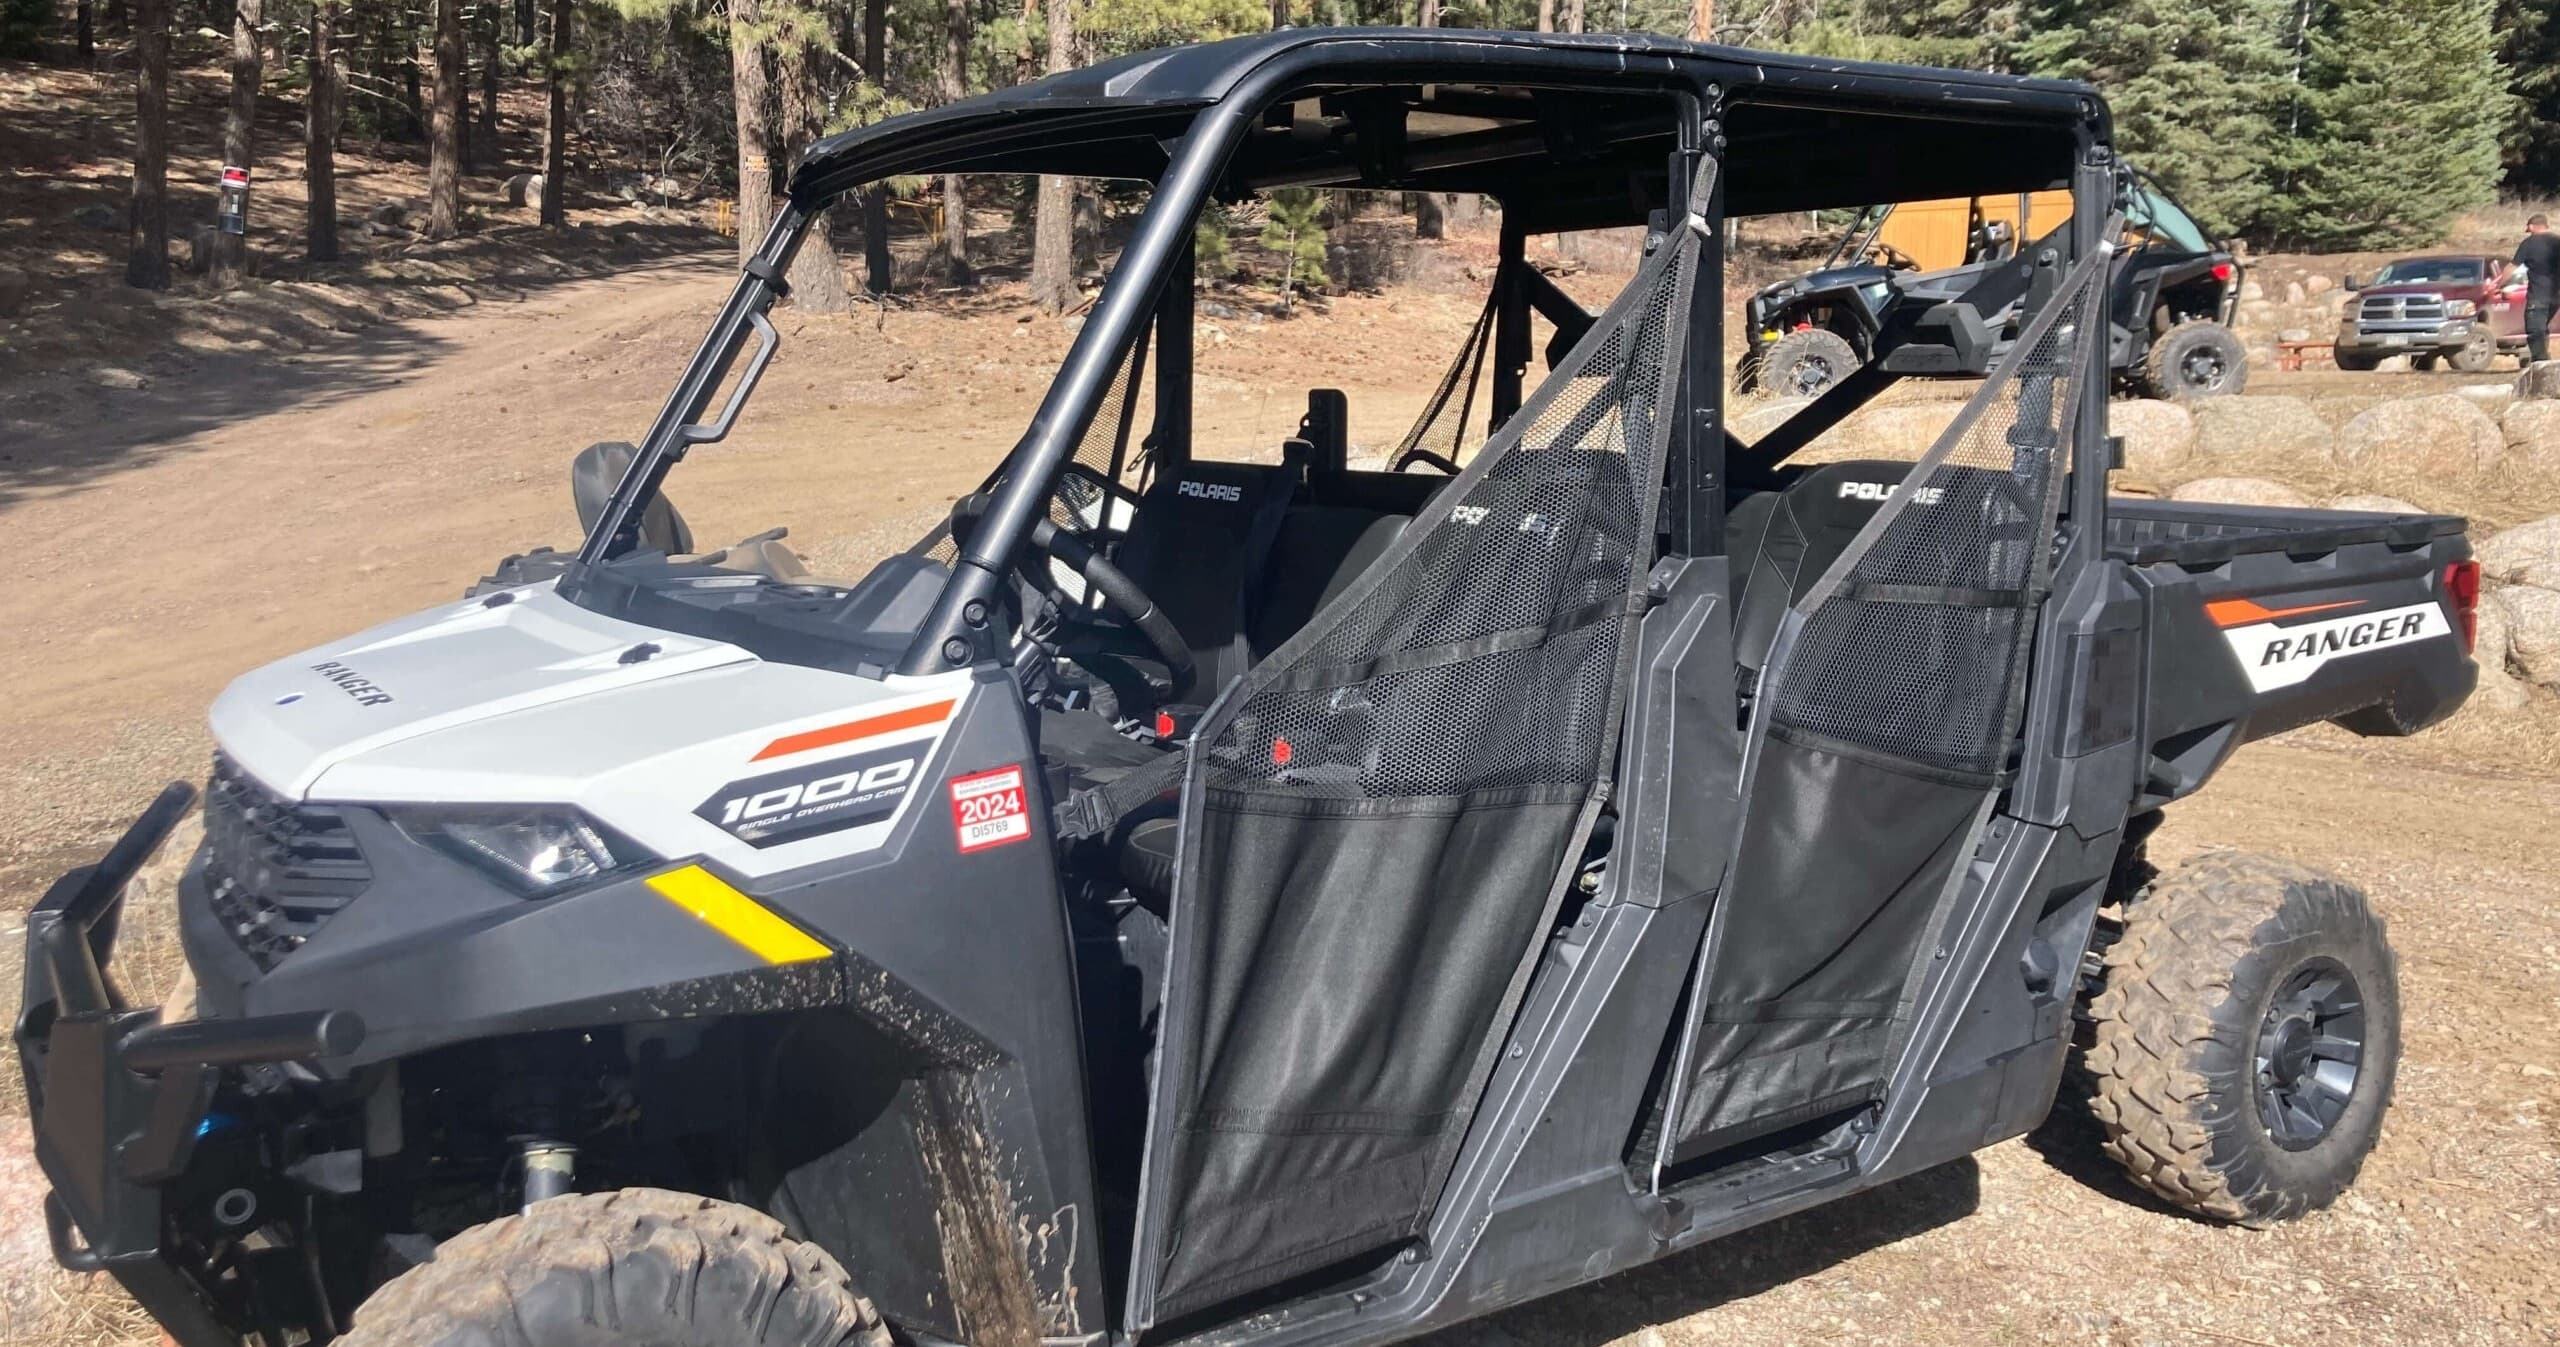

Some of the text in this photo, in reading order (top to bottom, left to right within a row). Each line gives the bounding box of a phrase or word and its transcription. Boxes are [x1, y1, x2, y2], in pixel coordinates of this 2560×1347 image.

[1178, 480, 1242, 502] POLARIS
[2260, 611, 2427, 667] RANGER
[309, 661, 394, 707] RANGER
[721, 758, 915, 824] 1000
[737, 785, 907, 832] SINGLE OVERHEAD CAM
[960, 789, 1021, 825] 2024
[972, 820, 1009, 839] DI5769
